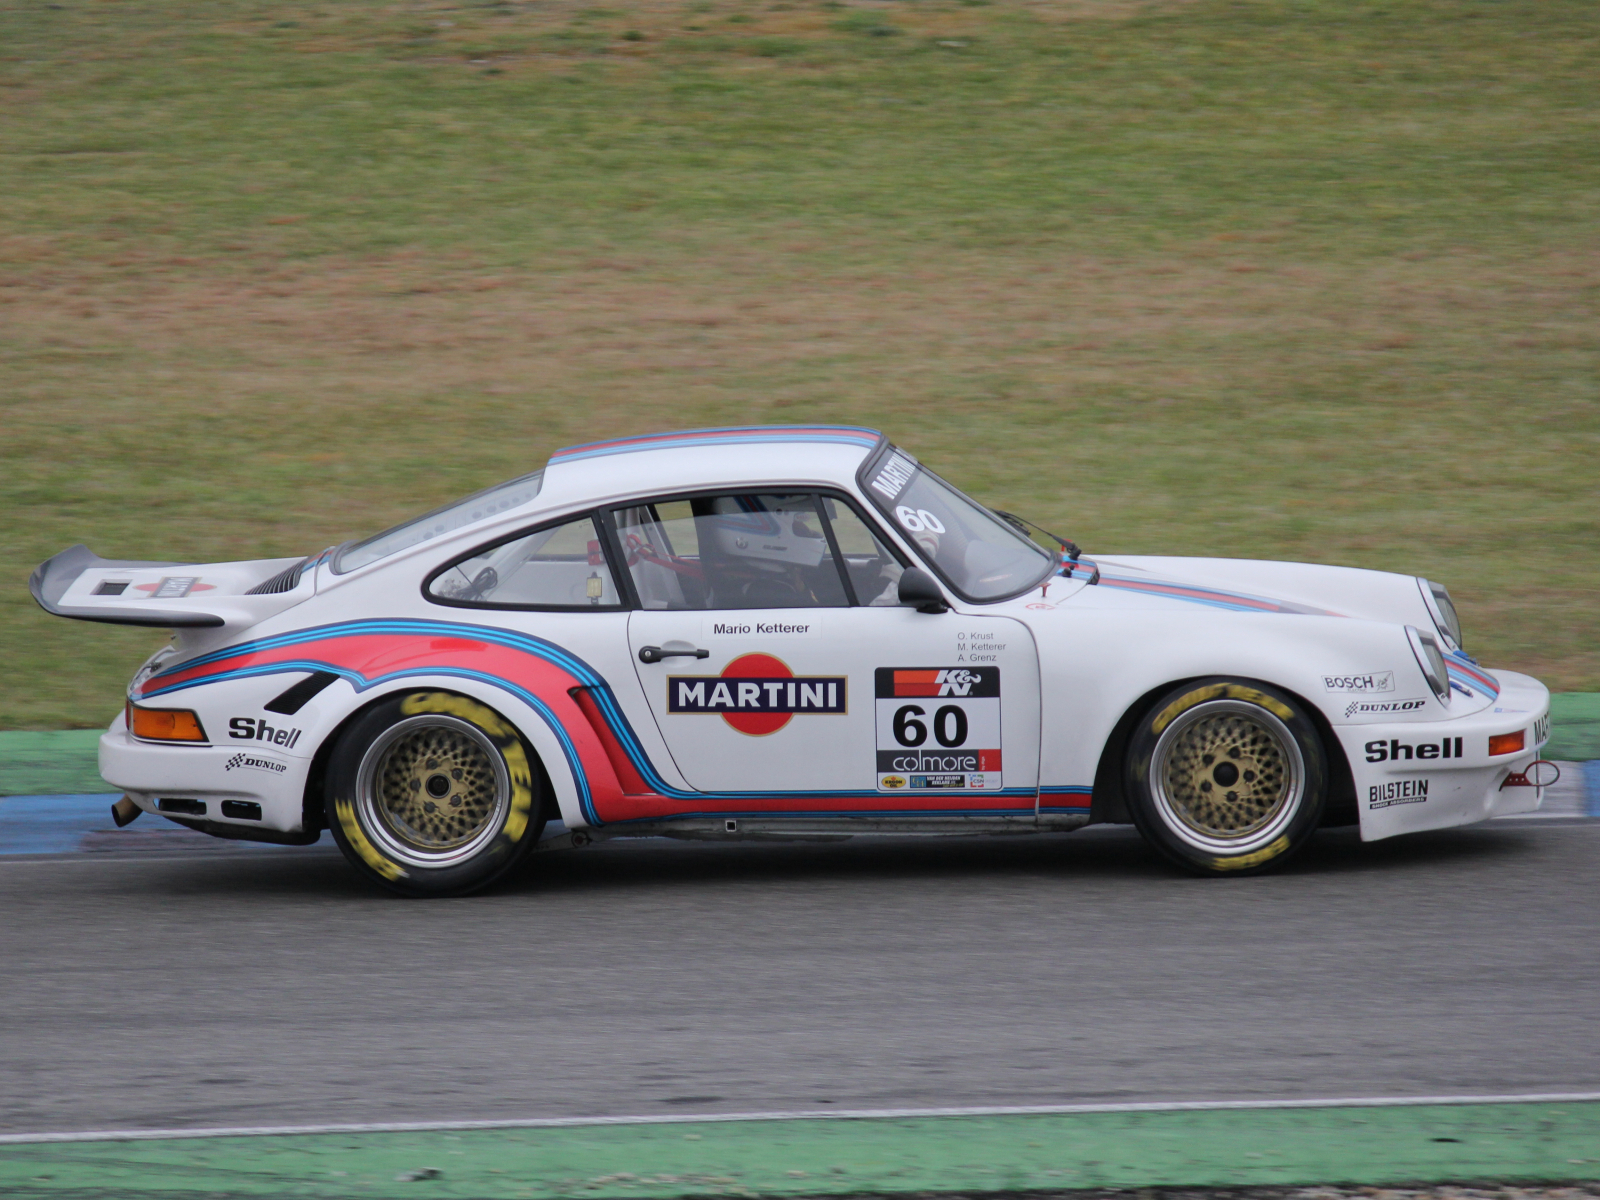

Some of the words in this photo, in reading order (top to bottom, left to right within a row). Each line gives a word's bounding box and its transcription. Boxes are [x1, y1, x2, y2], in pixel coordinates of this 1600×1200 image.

[895, 505, 946, 533] 60
[713, 623, 751, 635] Mario
[756, 622, 810, 634] Ketterer
[957, 631, 968, 641] O.
[970, 631, 994, 640] Krust
[957, 642, 969, 651] M.
[971, 642, 1007, 651] Ketterer
[957, 653, 967, 662] A.
[969, 653, 997, 662] Grenz
[1324, 675, 1375, 689] BOSCH
[678, 681, 837, 708] MARTINI
[1359, 700, 1426, 712] DUNLOP
[228, 716, 302, 749] Shell
[892, 704, 968, 748] 60
[1364, 736, 1463, 764] Shell
[243, 757, 287, 773] DUNLOP
[892, 749, 977, 771] colmore
[1369, 779, 1428, 803] BILSTEIN
